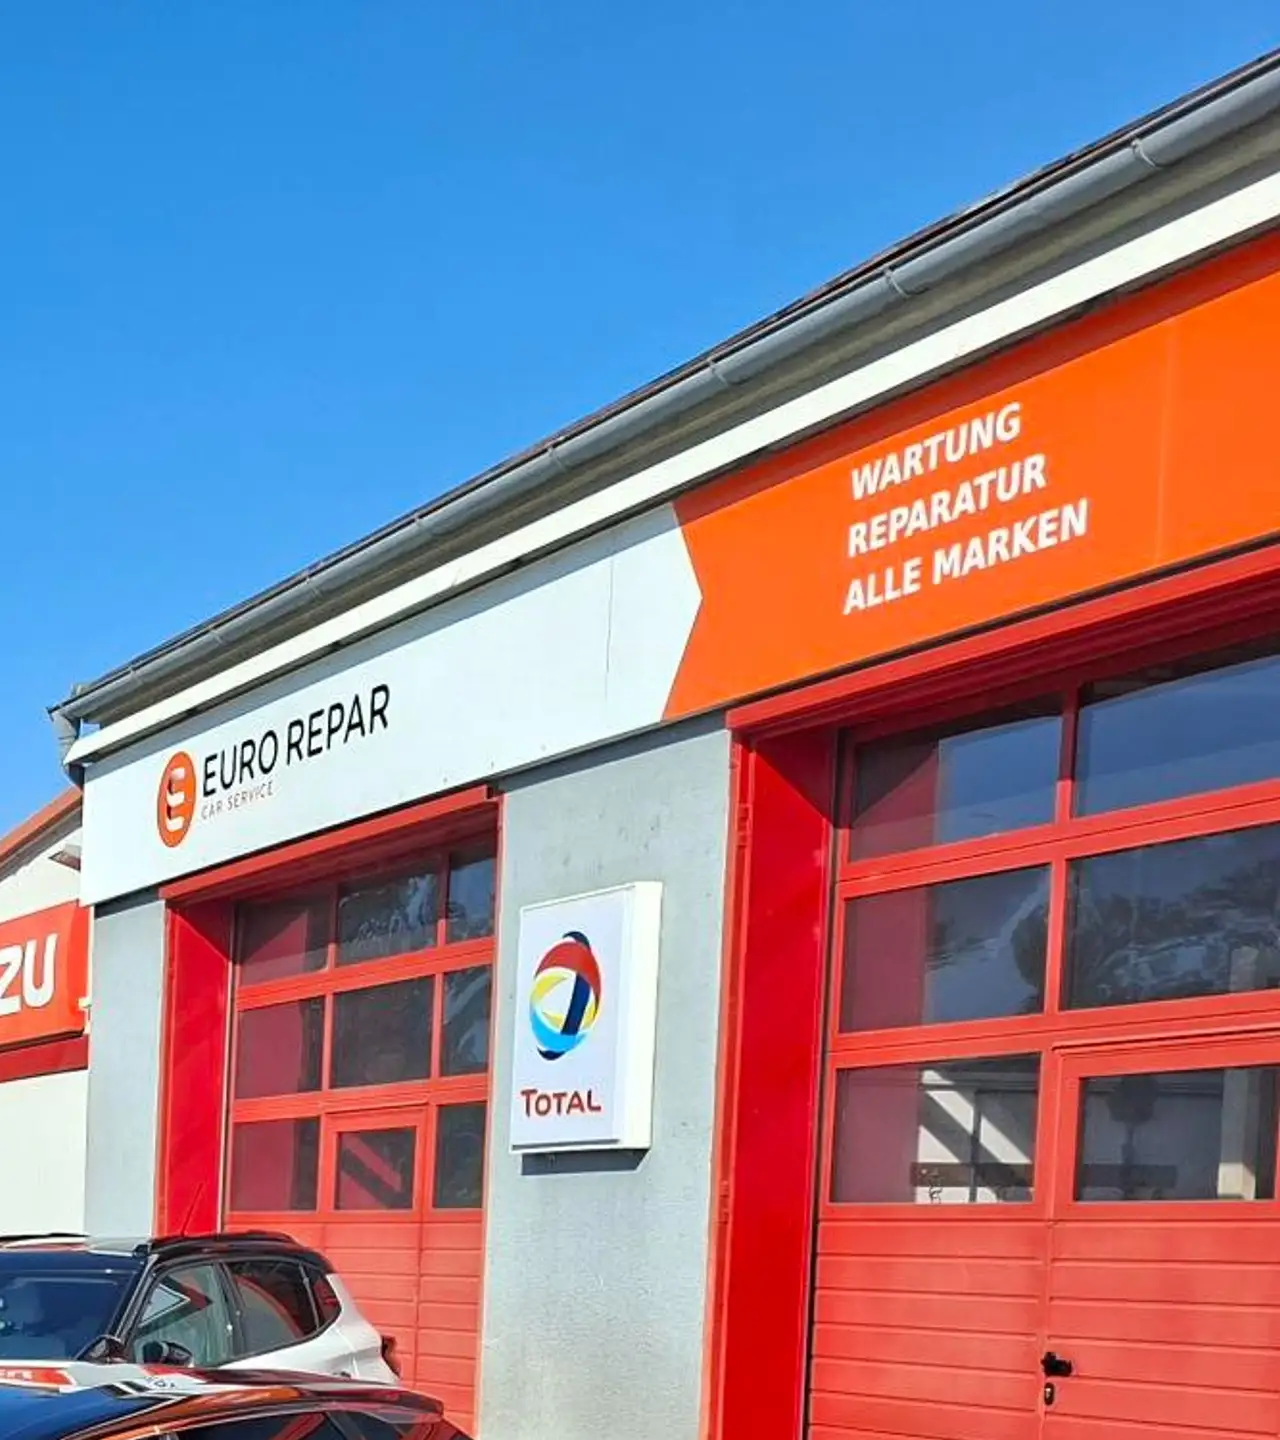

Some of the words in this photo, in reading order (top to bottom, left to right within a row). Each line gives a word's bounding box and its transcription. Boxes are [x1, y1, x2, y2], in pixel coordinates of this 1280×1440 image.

[851, 402, 1022, 500] WARTUNG
[848, 453, 1047, 557] REPARATUR
[843, 557, 922, 615] ALLE
[931, 497, 1090, 585] MARKEN
[203, 728, 278, 797] EURO
[287, 683, 391, 766] REPAR
[201, 802, 223, 820] CAR
[227, 782, 274, 810] SERVICE
[520, 1088, 602, 1118] TOTAL
